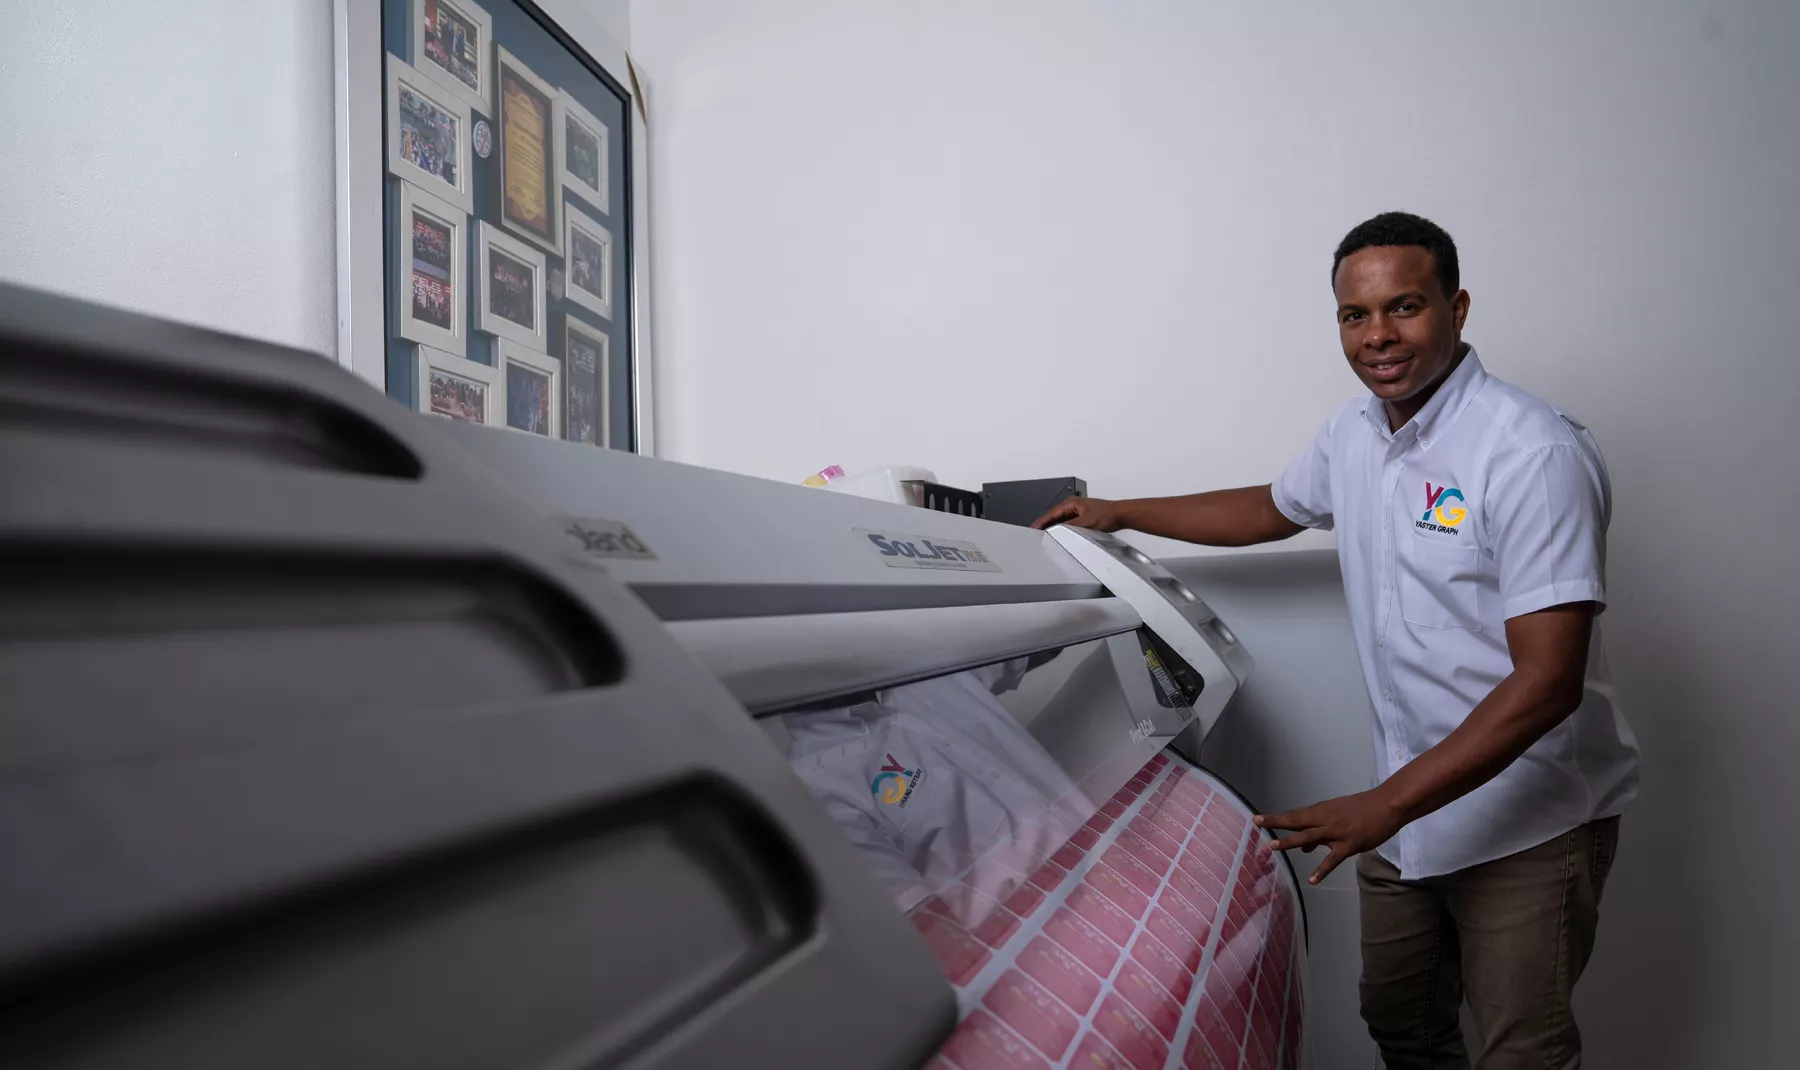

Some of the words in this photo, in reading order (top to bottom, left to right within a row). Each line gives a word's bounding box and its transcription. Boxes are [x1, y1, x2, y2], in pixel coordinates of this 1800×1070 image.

[1422, 481, 1467, 527] YG
[1415, 520, 1437, 532] YASTER
[1437, 525, 1459, 536] GRAPH
